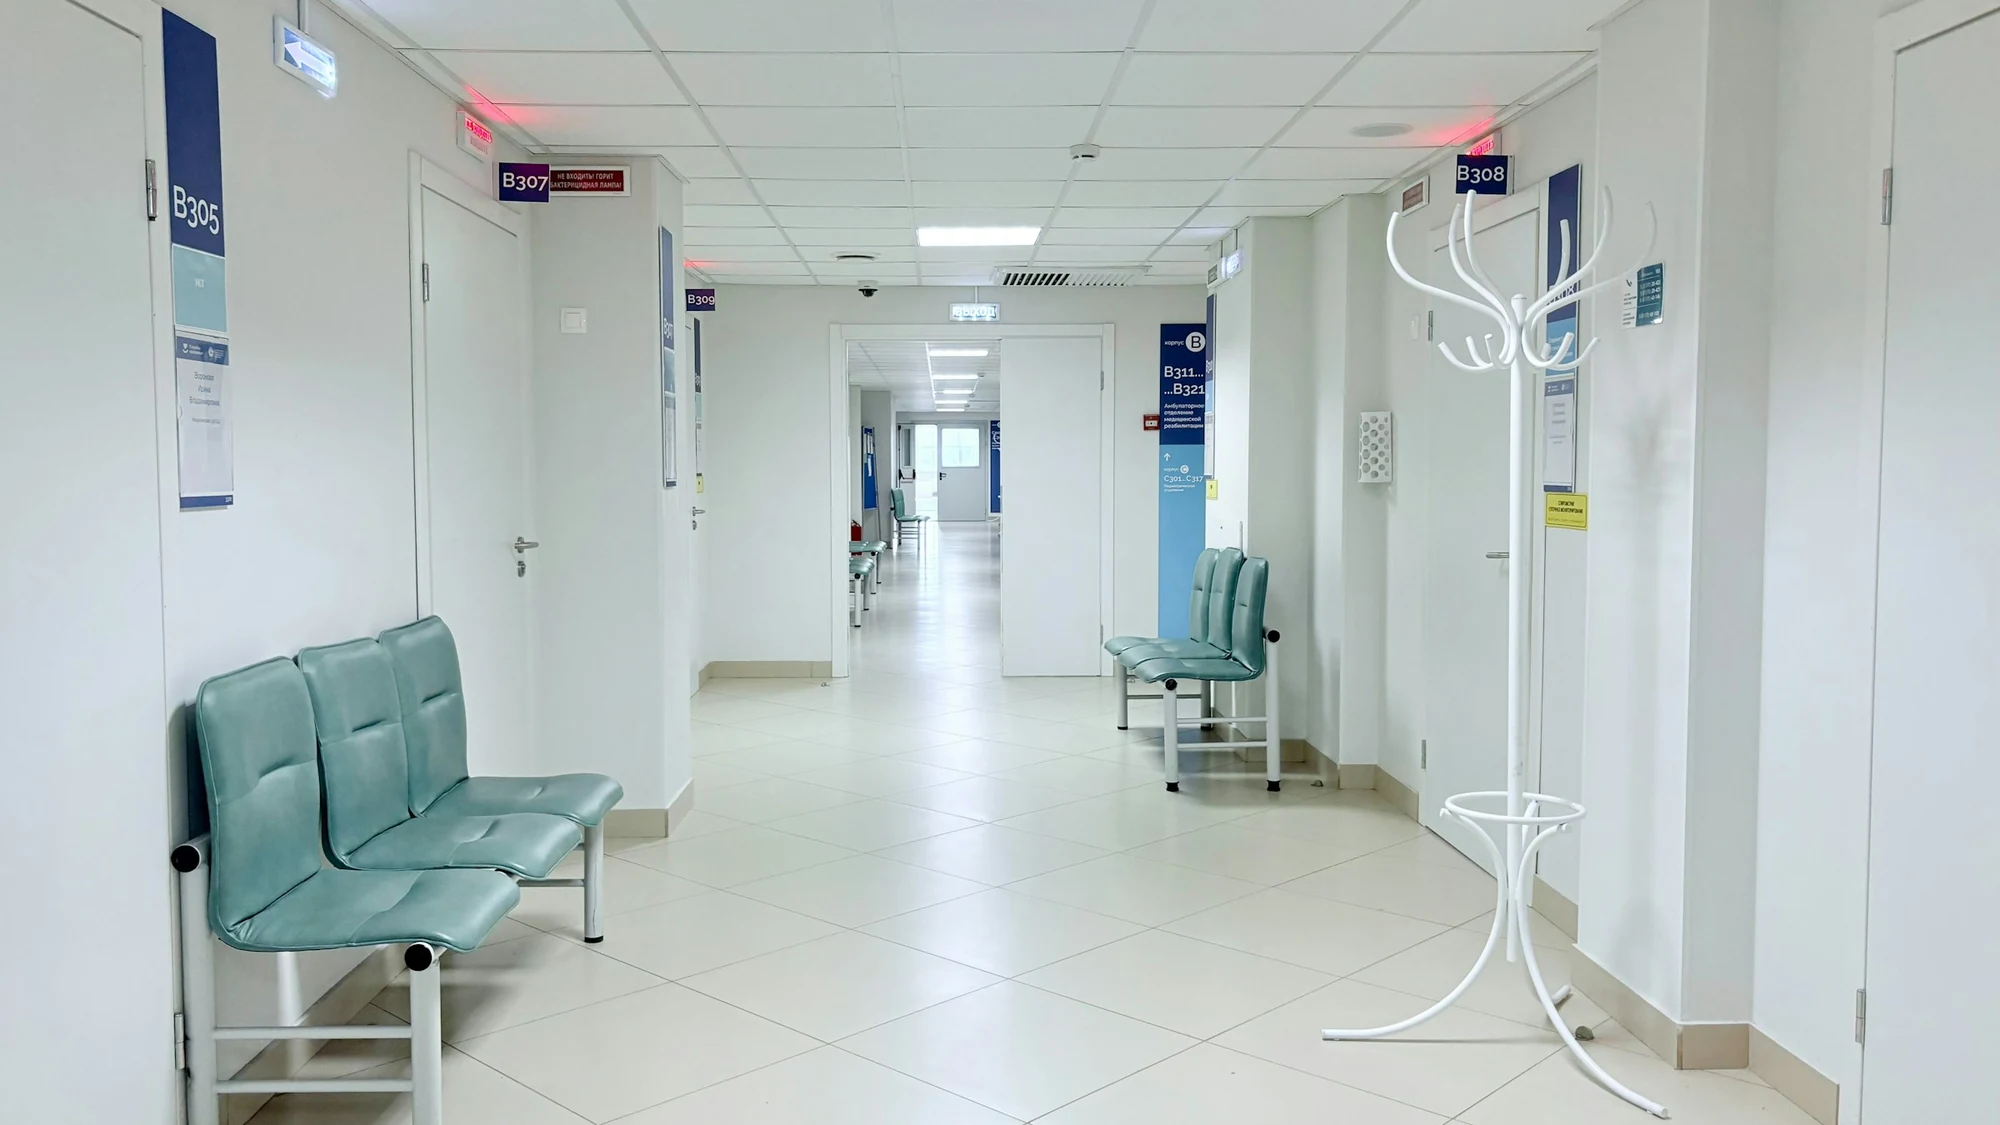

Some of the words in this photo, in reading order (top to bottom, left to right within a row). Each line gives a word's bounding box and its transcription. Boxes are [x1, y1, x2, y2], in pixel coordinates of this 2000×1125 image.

[503, 172, 549, 192] B307
[557, 172, 566, 180] НЕ
[566, 172, 595, 181] ВХОДИТЬ!
[1457, 165, 1505, 184] B308
[599, 181, 622, 189] ЛАМПА!
[173, 184, 220, 235] B305
[687, 294, 715, 306] B309
[952, 306, 996, 318] ВЫХОД
[1164, 365, 1204, 380] B311...
[1163, 382, 1206, 397] ...B321
